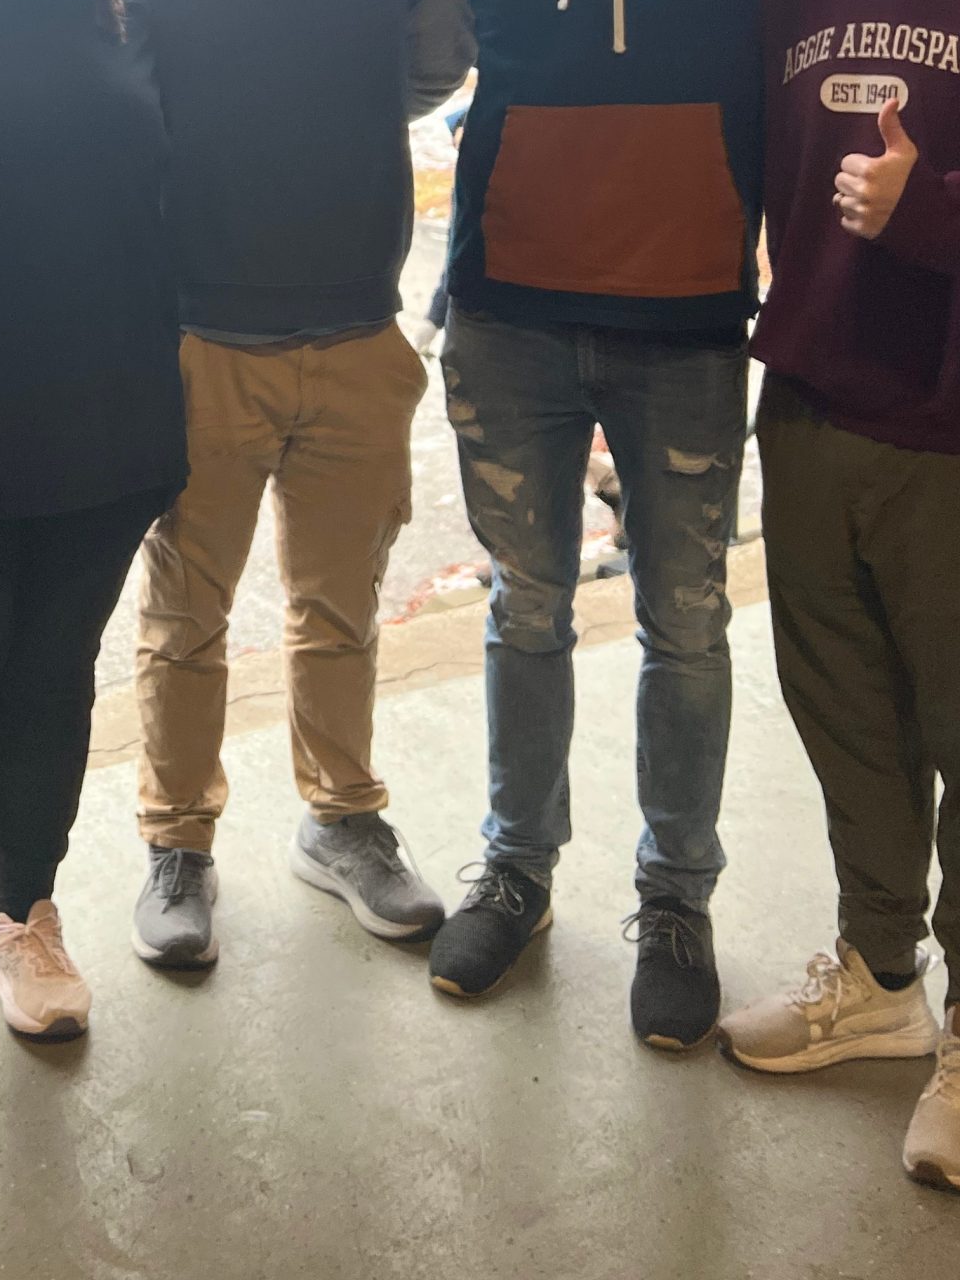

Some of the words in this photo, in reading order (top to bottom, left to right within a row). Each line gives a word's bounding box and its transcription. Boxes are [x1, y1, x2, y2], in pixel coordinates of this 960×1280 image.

[782, 26, 836, 85] AGGIE
[837, 22, 960, 74] AEROSPA
[830, 82, 862, 104] EST.
[865, 83, 899, 105] 1940
